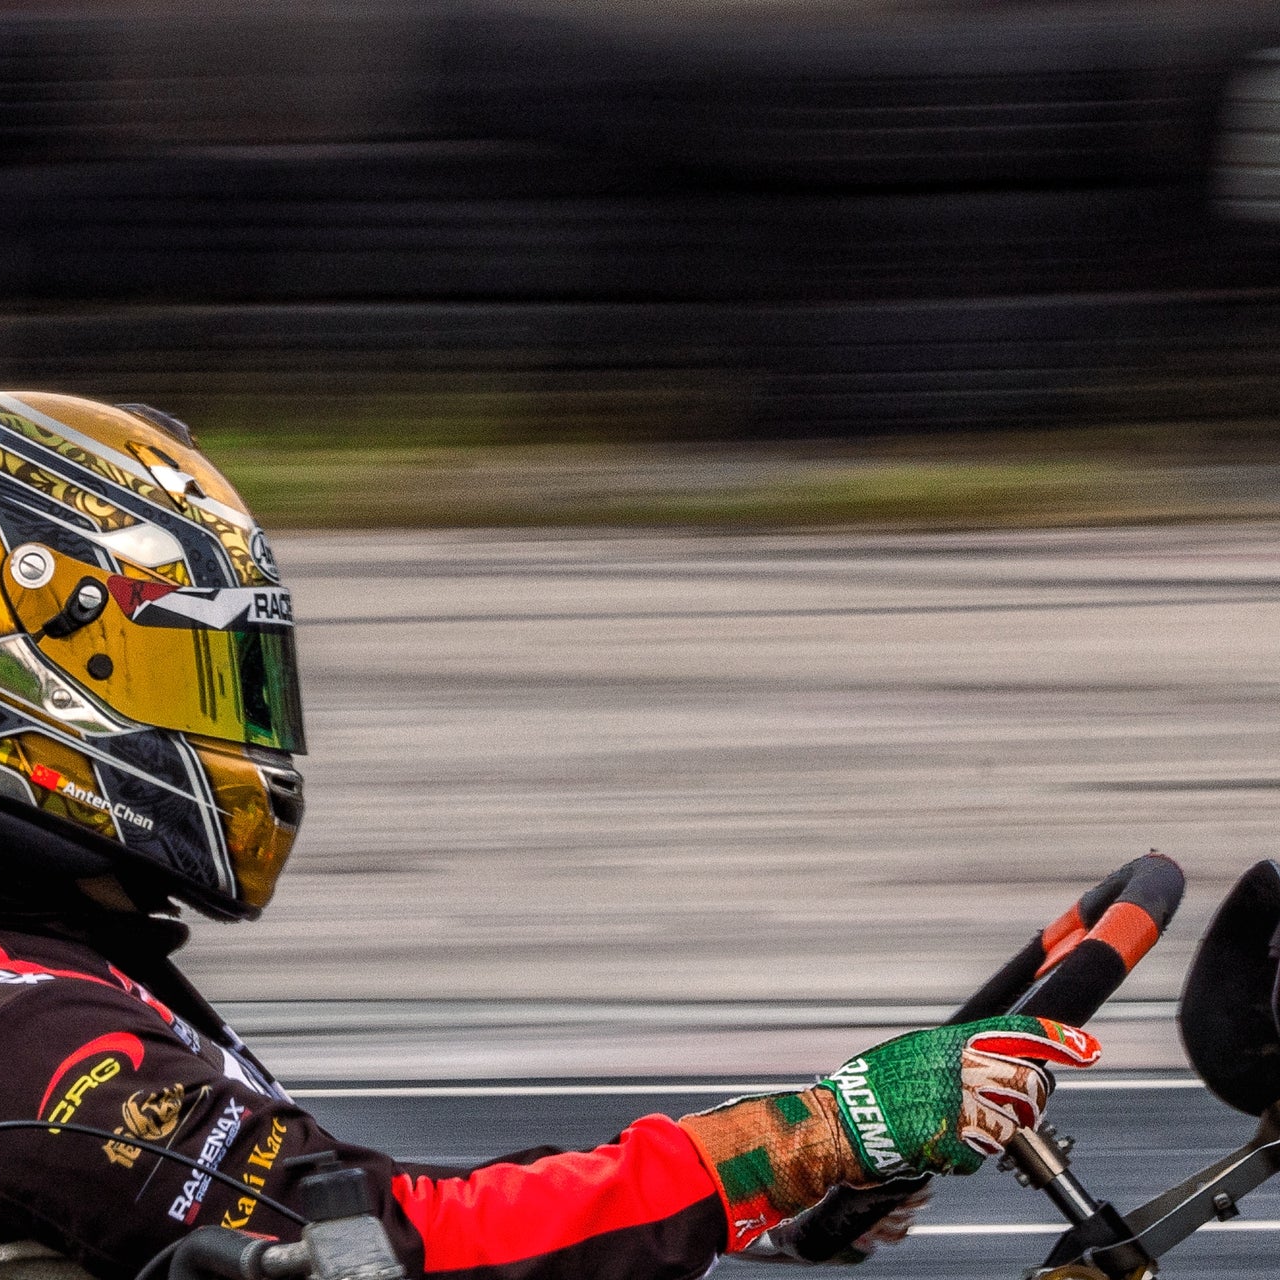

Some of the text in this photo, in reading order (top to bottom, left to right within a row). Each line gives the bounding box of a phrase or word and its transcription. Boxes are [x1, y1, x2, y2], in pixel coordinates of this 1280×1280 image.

[62, 780, 155, 831] Anter Chan
[48, 1056, 121, 1135] CRG
[829, 1057, 912, 1174] RACEMA
[220, 1116, 288, 1230] Kai Kart
